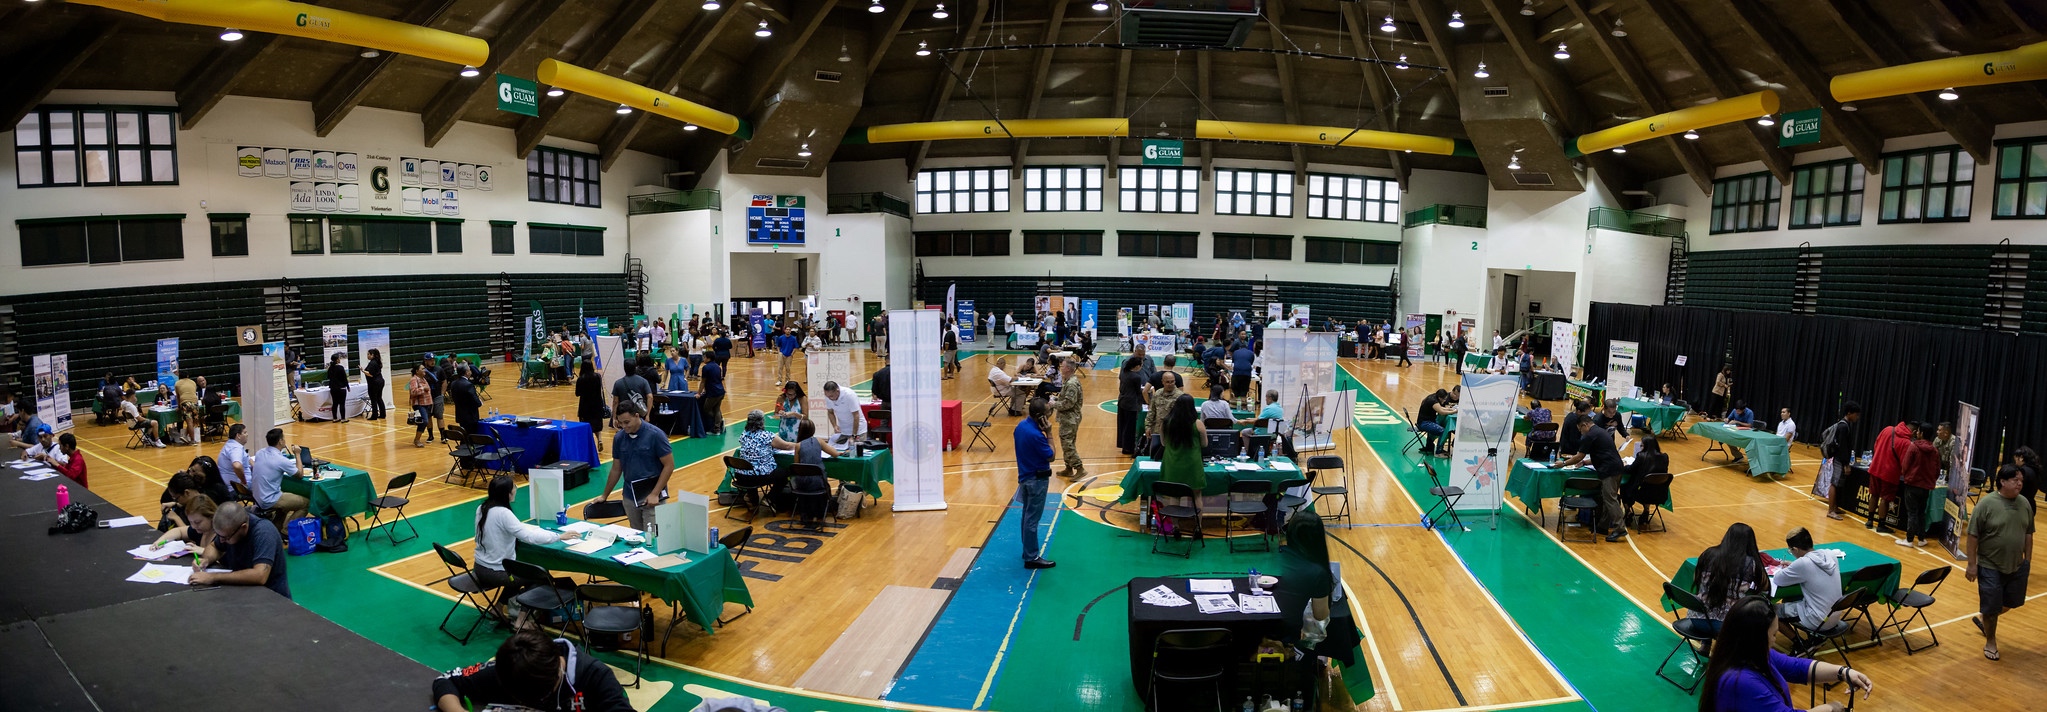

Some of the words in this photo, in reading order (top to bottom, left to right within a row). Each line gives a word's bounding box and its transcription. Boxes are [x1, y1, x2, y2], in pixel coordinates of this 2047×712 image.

[514, 92, 535, 103] GUAM
[1796, 122, 1818, 132] GUAM
[293, 193, 311, 203] Ada
[715, 225, 718, 234] 1
[835, 228, 840, 237] 1
[1472, 242, 1478, 250] 2
[1588, 245, 1591, 254] 2
[1174, 308, 1188, 318] FUN
[533, 309, 544, 340] CNAS
[1610, 344, 1637, 353] GuamTemps
